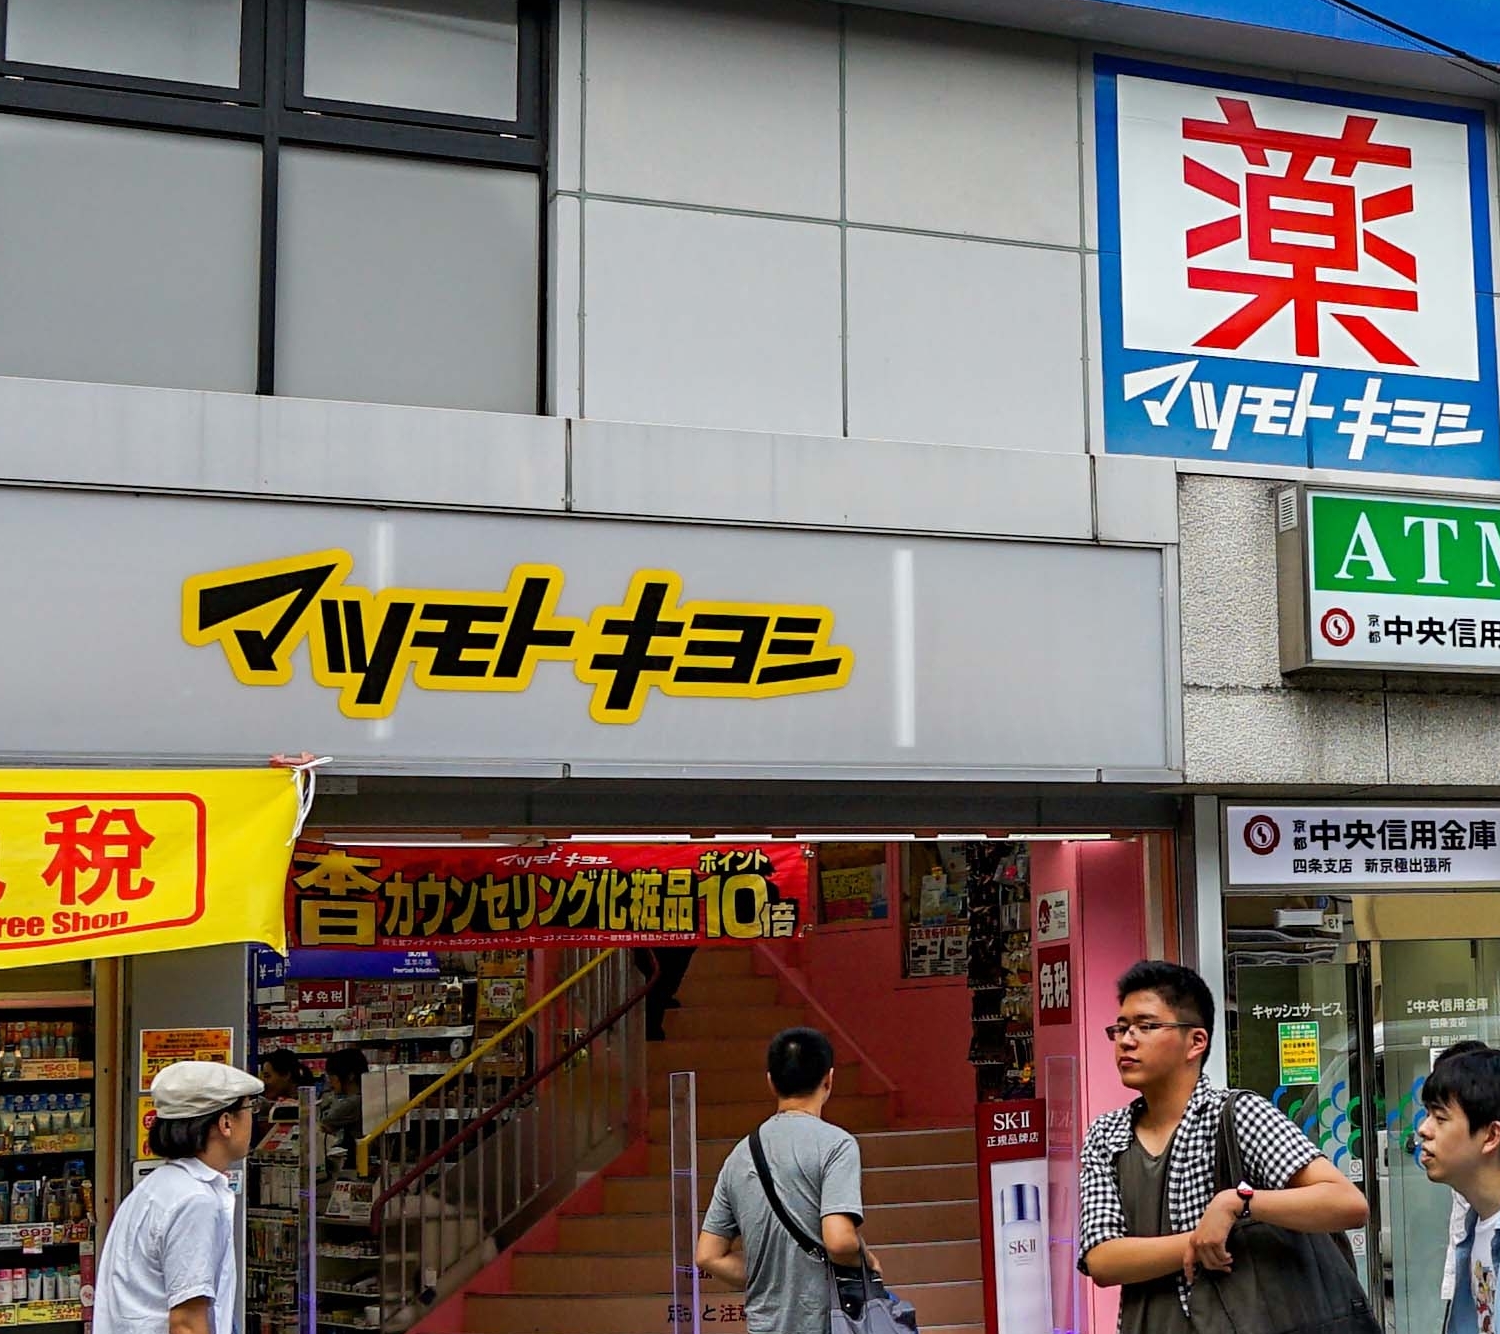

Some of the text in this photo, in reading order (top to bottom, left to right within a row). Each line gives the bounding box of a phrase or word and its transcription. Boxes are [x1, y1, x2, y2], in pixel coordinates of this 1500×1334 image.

[1182, 97, 1420, 367] 薬
[1123, 360, 1484, 460] マツモトキヨシ
[197, 561, 842, 712] マツモトキヨシ
[1292, 818, 1498, 852] 京都 中央信用金庫
[699, 850, 769, 873] ポイント
[1292, 857, 1452, 874] 四条支店 新京極出張所
[384, 868, 695, 937] カウンセリング化粧品
[697, 874, 797, 939] 10倍
[52, 908, 129, 937] Shop
[1252, 1001, 1344, 1020] キャッシュサービス
[1413, 998, 1488, 1014] 中央信用金庫
[993, 1112, 1030, 1131] SK-II
[1008, 1240, 1037, 1255] SK-II
